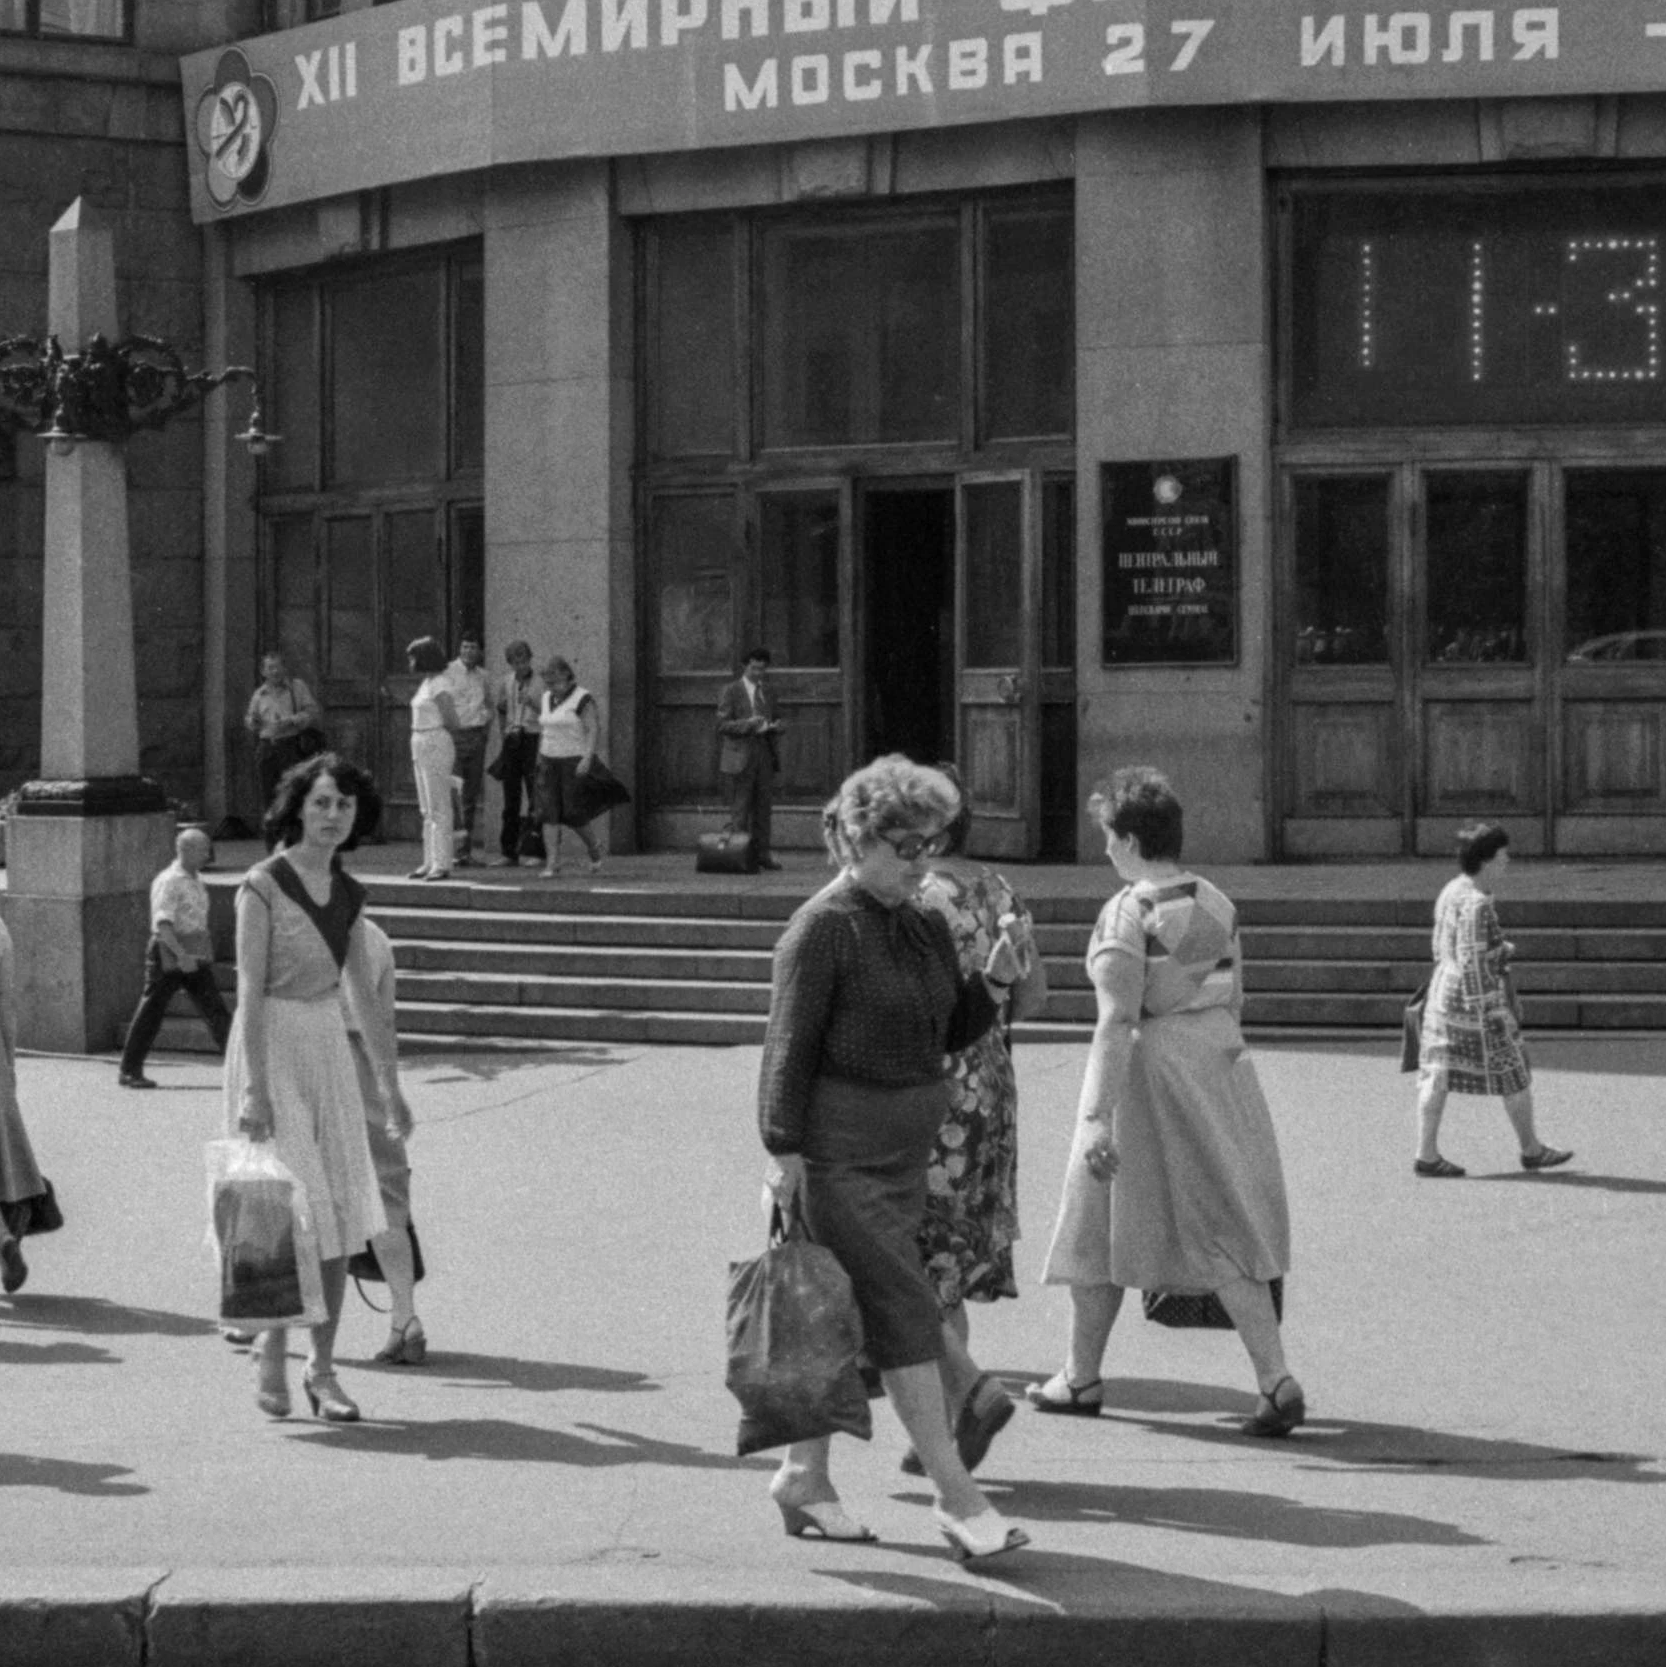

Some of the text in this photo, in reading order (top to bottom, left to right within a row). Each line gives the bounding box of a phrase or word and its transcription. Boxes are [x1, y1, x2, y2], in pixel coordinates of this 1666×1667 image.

[721, 27, 1045, 112] МОСКВА
[1103, 17, 1217, 76] 27
[1299, 5, 1563, 68] ИЮЛЯ
[1133, 577, 1206, 593] ТЕЛЕГРАФ
